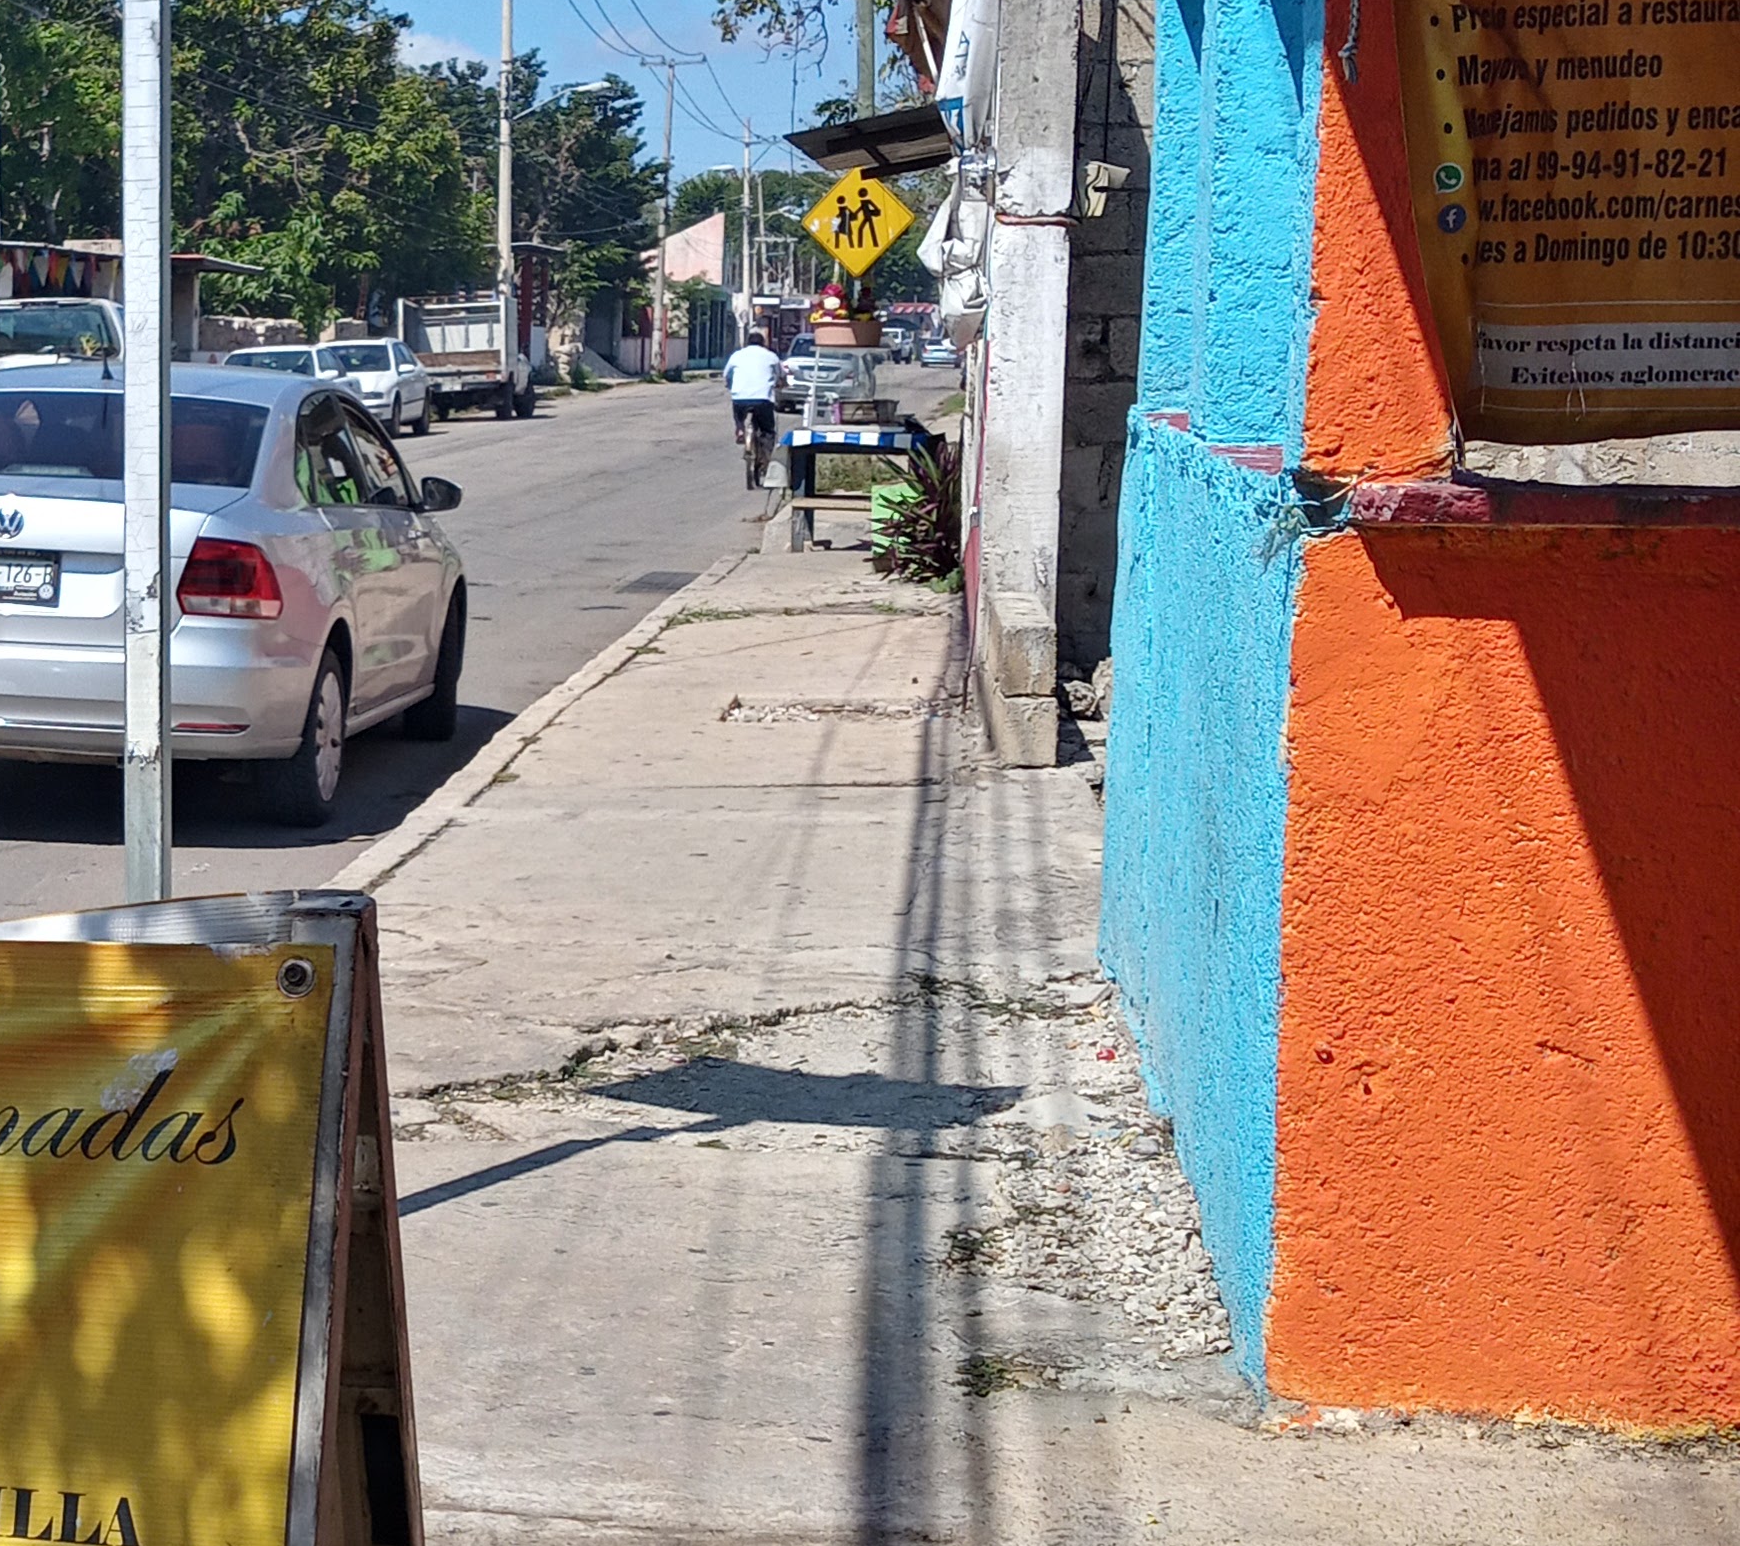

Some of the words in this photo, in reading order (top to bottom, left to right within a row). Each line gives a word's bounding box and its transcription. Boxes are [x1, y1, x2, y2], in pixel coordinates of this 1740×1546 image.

[1617, 1, 1633, 25] a
[1536, 58, 1549, 85] y
[1557, 49, 1663, 80] menudeo
[1566, 100, 1658, 138] pedidos
[1665, 107, 1680, 137] y
[1508, 152, 1531, 181] al
[1536, 147, 1727, 179] 99-94-91-82-21
[1513, 239, 1527, 263] a
[1534, 231, 1630, 267] Domingo
[1638, 230, 1668, 260] de
[1536, 334, 1616, 355] respeta
[1622, 332, 1643, 350] la
[1510, 366, 1614, 385] Evitemos
[1620, 365, 1740, 386] aglomerac
